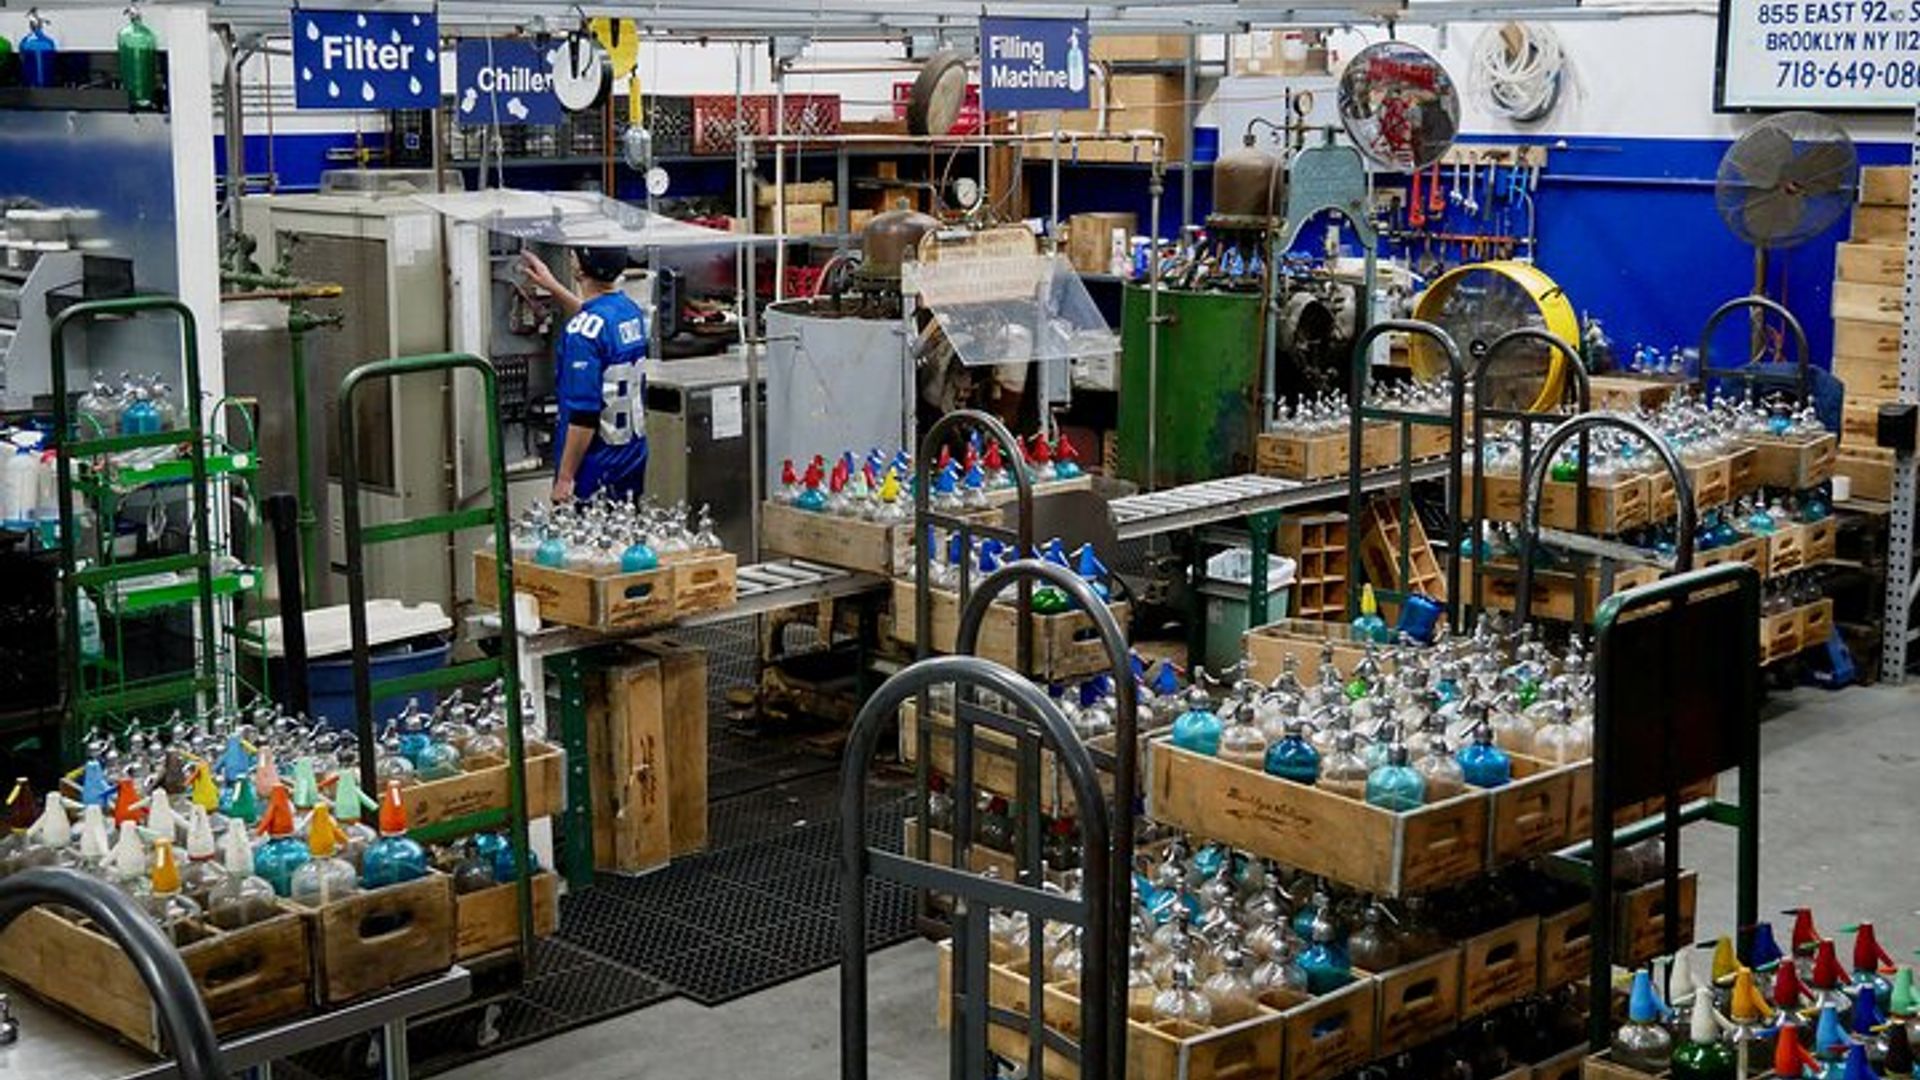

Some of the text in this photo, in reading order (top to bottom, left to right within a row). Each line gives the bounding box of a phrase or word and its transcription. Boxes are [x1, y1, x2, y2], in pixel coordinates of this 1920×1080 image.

[1758, 4, 1798, 24] 855
[1805, 3, 1855, 24] EAST
[322, 35, 414, 70] Filter
[990, 36, 1044, 65] Filling
[1766, 31, 1855, 51] BROOKLYN
[1863, 32, 1889, 51] NY
[477, 66, 553, 92] Chiller
[991, 65, 1068, 88] Machine
[1776, 60, 1920, 89] 718-649-08
